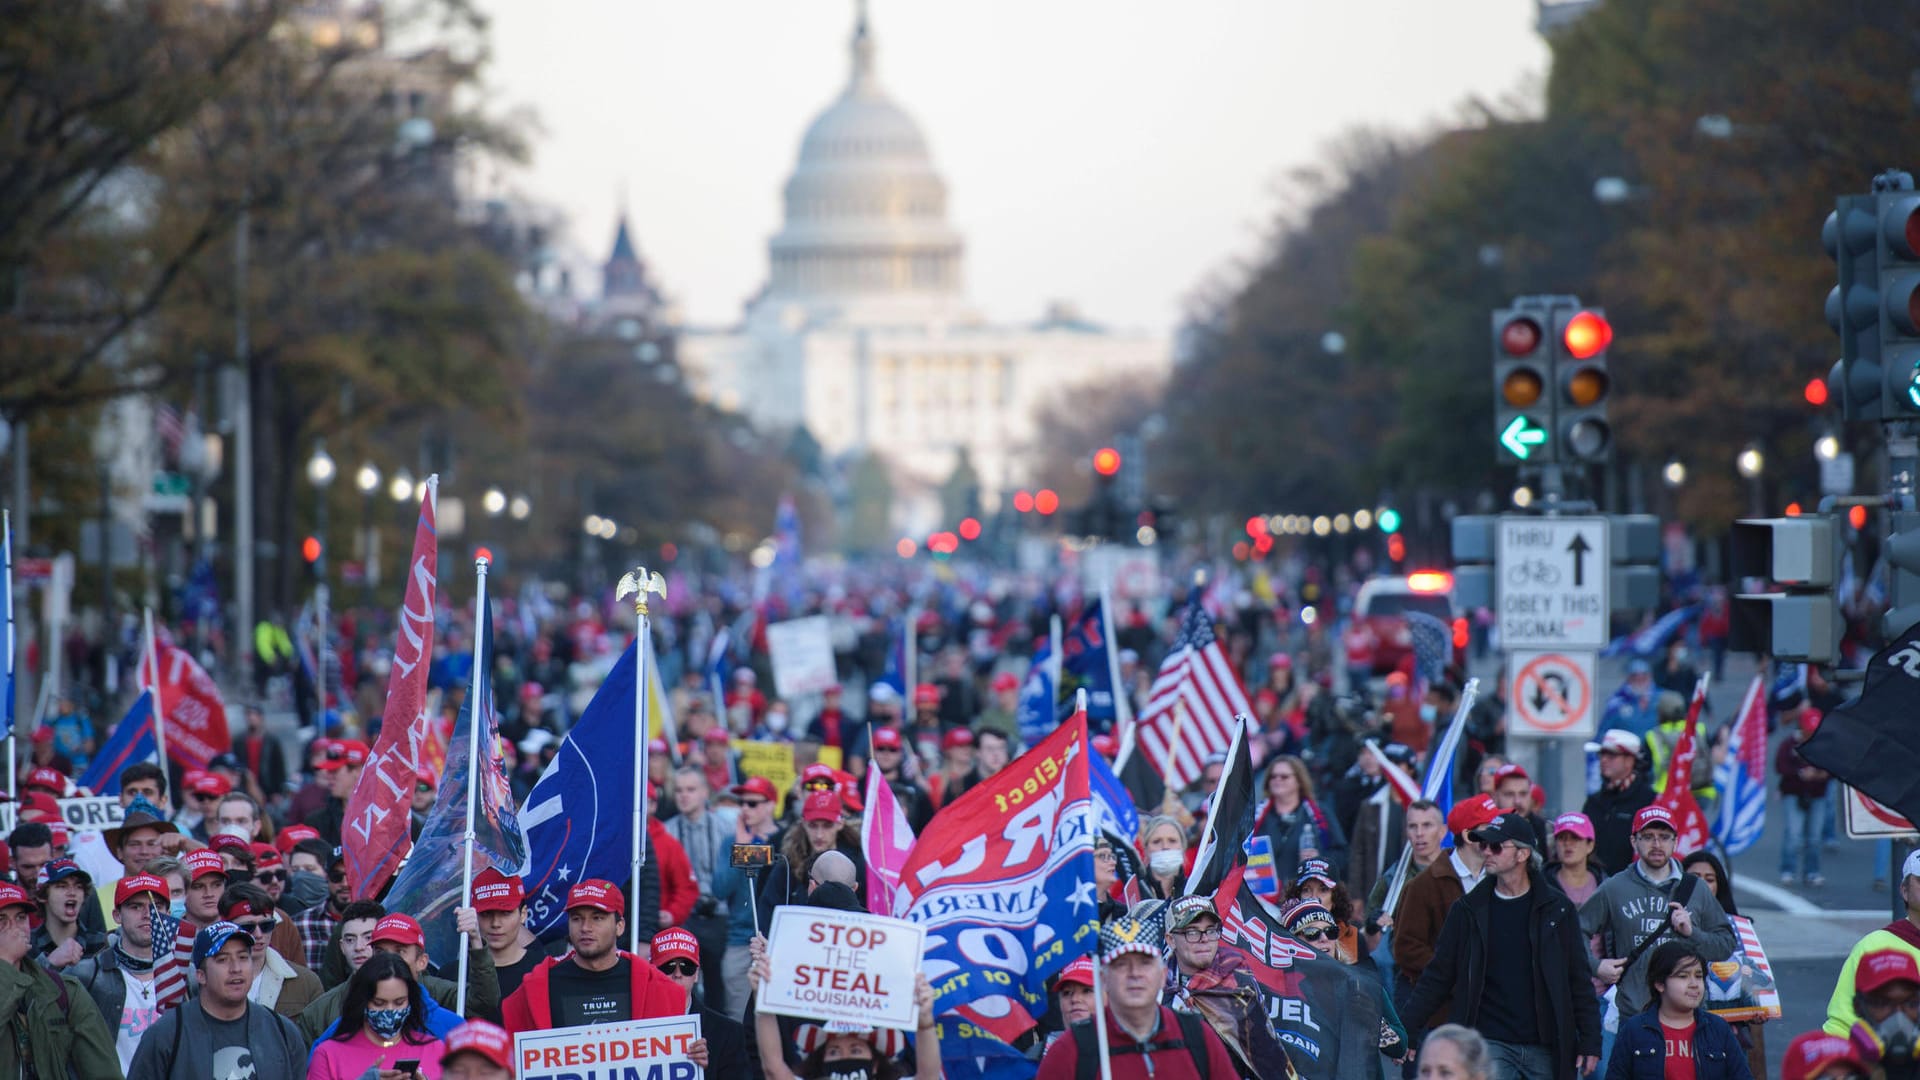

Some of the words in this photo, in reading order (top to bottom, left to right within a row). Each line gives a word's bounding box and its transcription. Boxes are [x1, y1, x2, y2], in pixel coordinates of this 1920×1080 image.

[1507, 528, 1554, 547] THRU
[1504, 594, 1553, 613] OBEY
[1562, 595, 1600, 615] THIS
[1506, 620, 1566, 638] SIGNAL
[66, 802, 124, 825] ORE
[1640, 808, 1671, 820] TRUMP
[655, 933, 672, 944] MAKE
[672, 932, 698, 945] AMERICA
[808, 922, 887, 950] STOP
[658, 942, 677, 952] GREAT
[679, 942, 696, 953] AGAIN
[822, 946, 869, 970] THE
[794, 964, 889, 996] STEAL
[583, 1001, 617, 1010] TRUMP
[794, 989, 882, 1010] LOUISIANA
[524, 1033, 694, 1070] PRESIDENT
